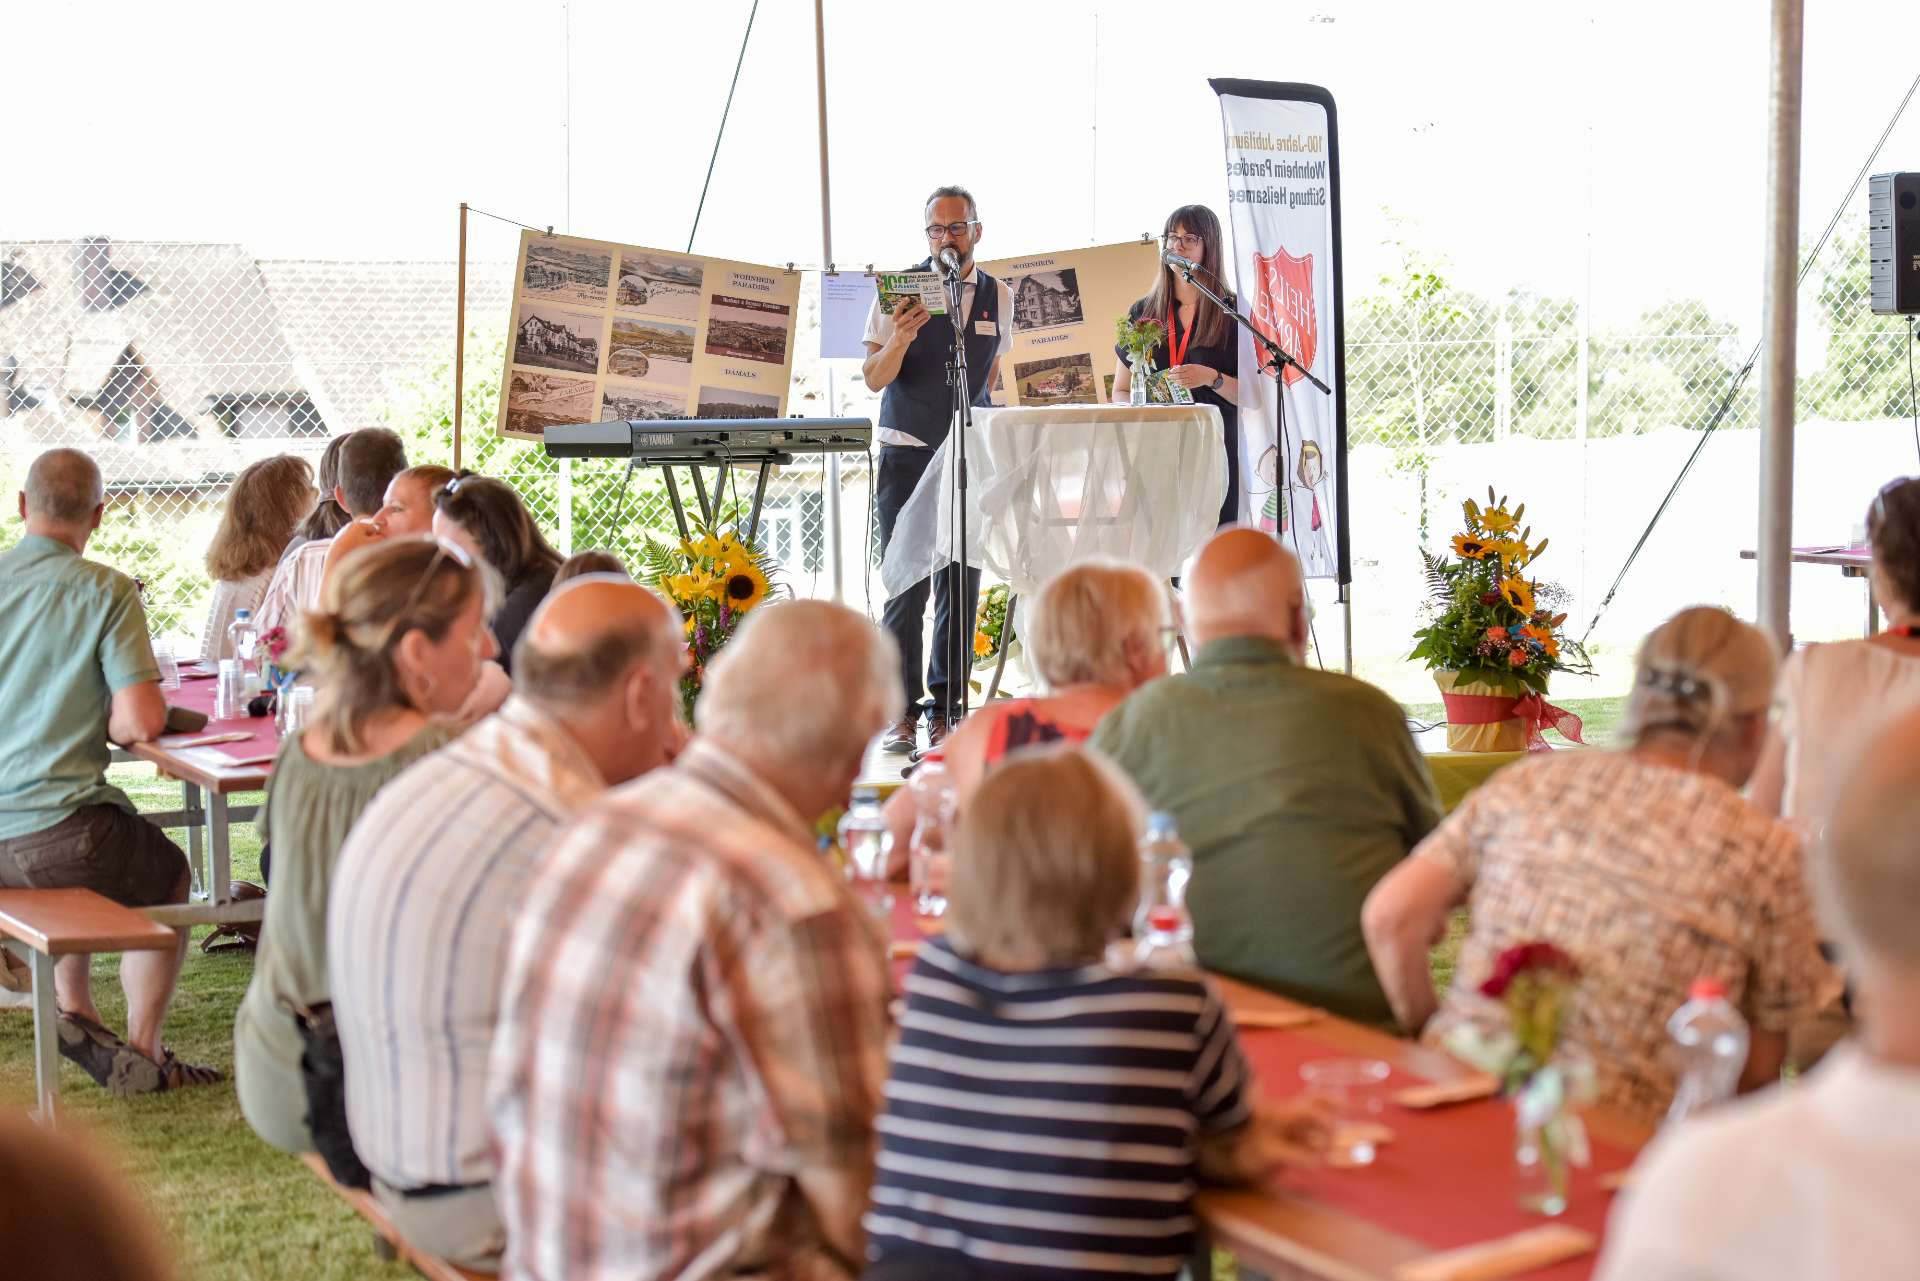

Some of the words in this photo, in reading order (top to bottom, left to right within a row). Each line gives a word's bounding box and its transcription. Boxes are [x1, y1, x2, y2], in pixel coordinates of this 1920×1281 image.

[734, 272, 775, 285] WOHNHEIM
[732, 280, 770, 292] PARADIES
[725, 367, 757, 378] DAMALS
[648, 433, 674, 446] YAMAHA
